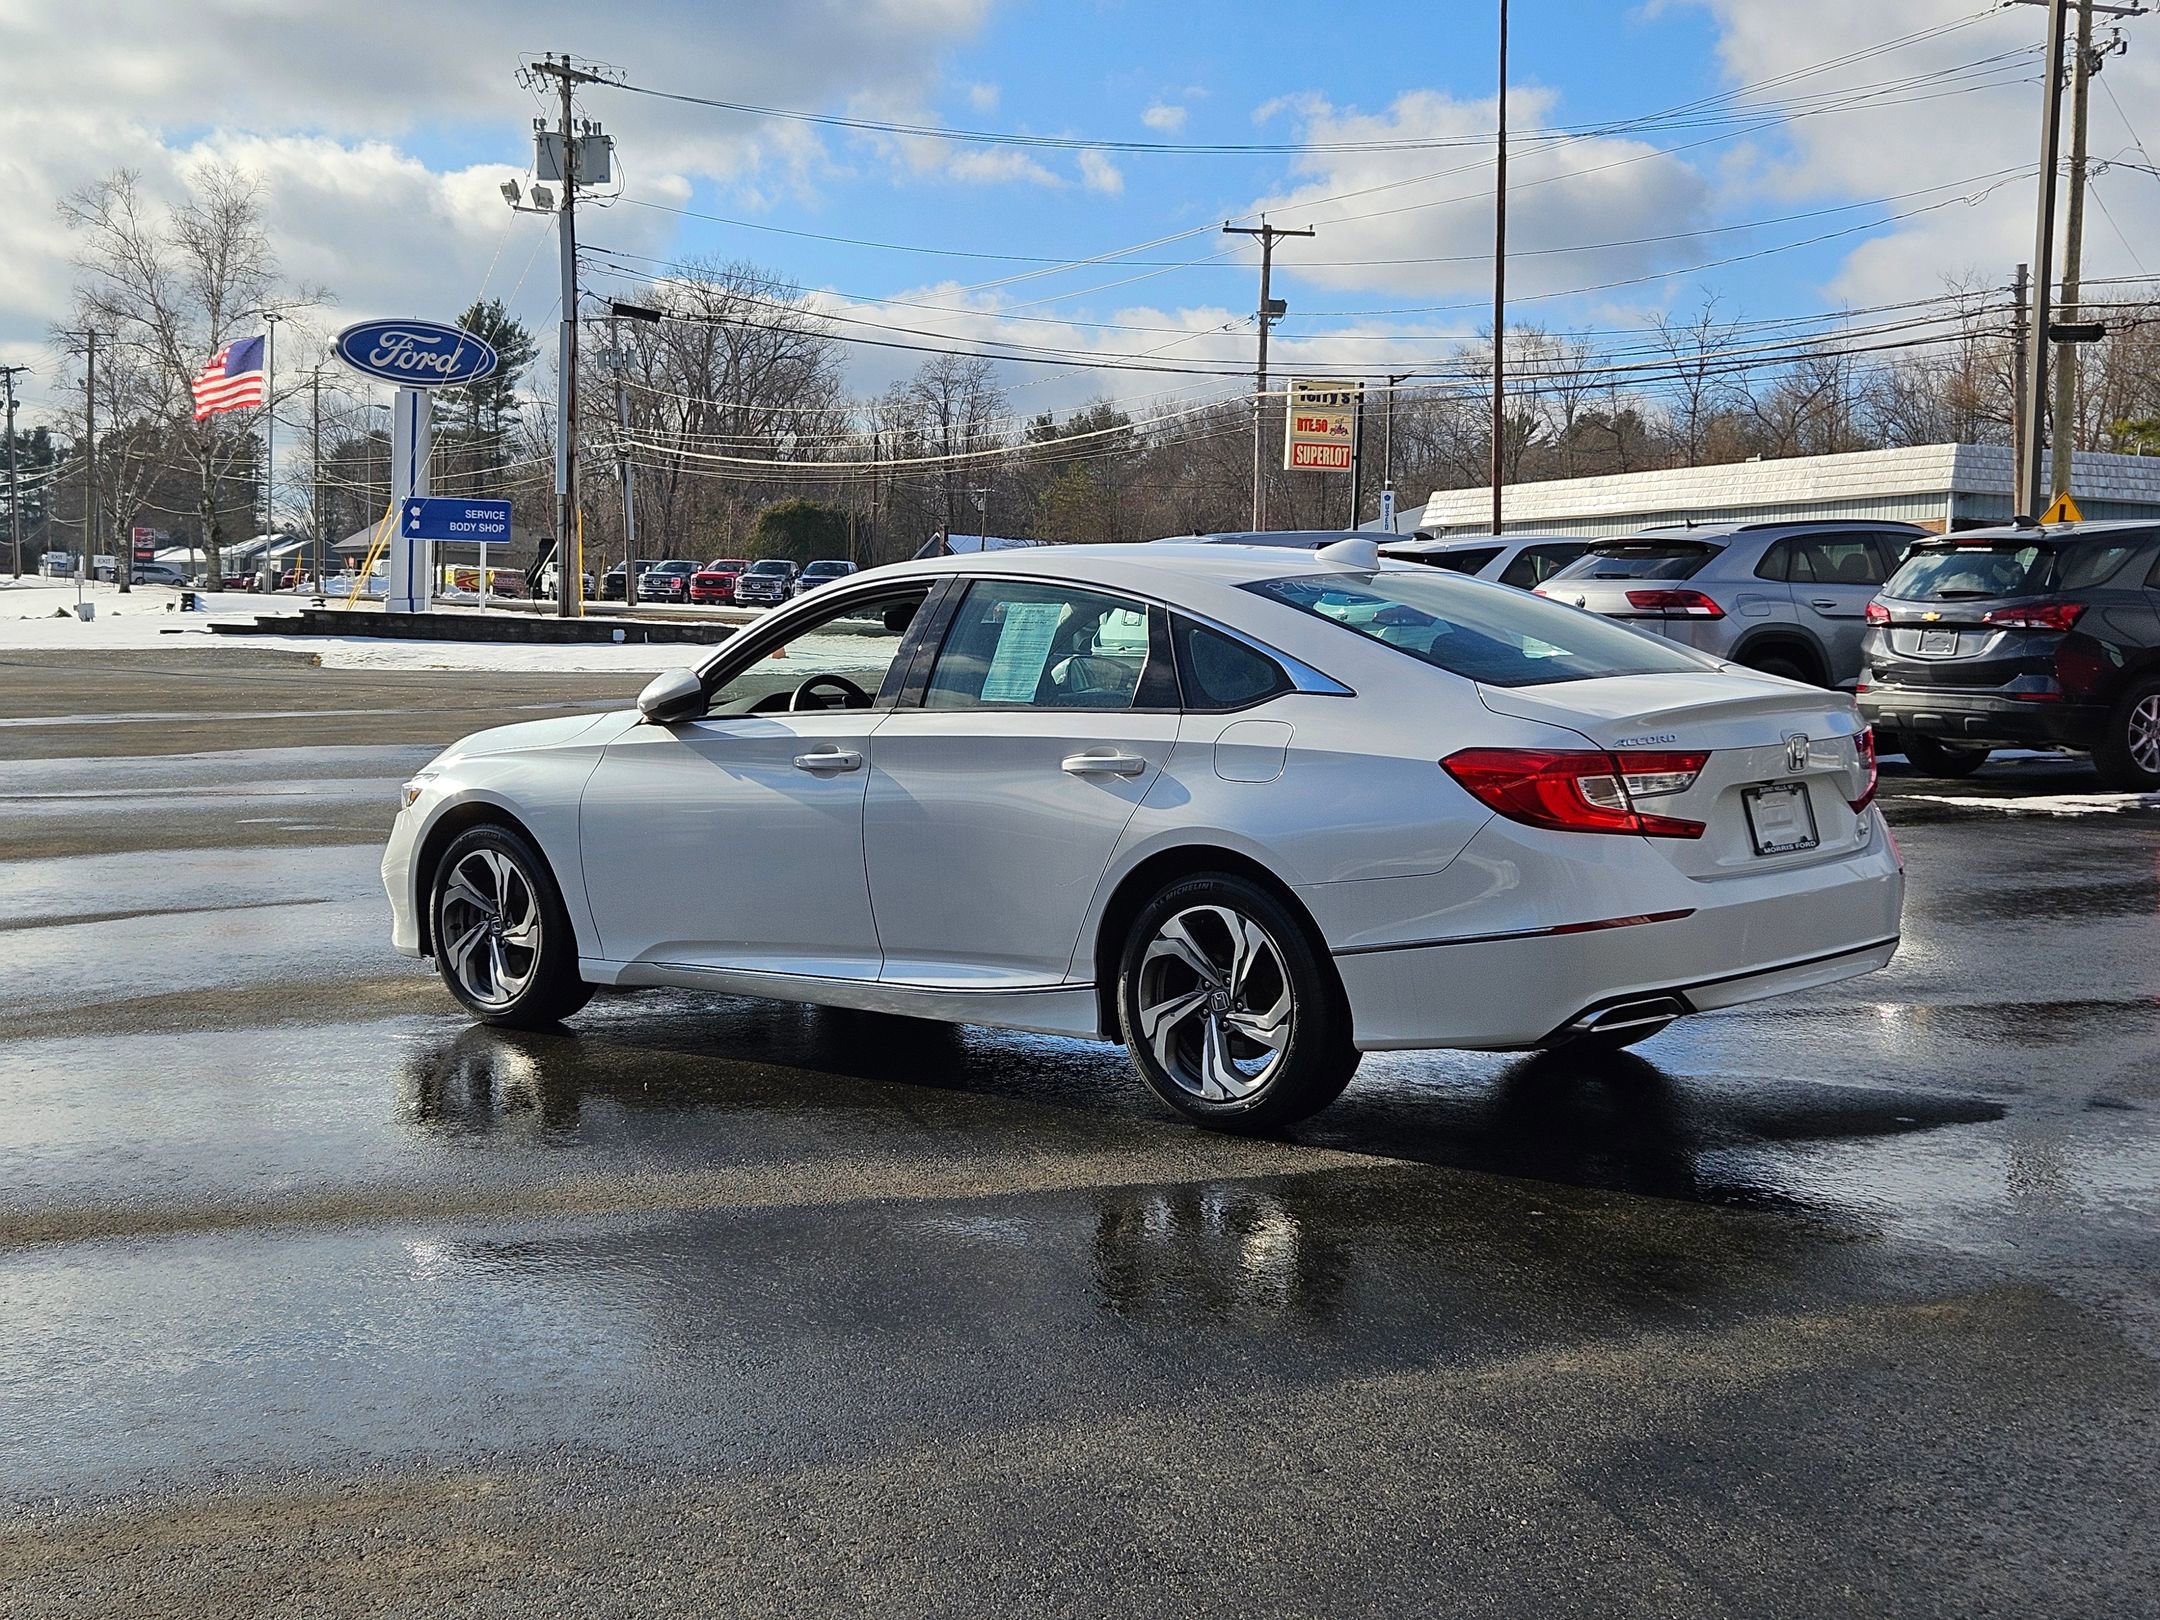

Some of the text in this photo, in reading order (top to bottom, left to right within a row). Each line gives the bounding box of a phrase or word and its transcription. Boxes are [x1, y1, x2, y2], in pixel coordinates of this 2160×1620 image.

[369, 330, 465, 374] Ford
[1296, 444, 1349, 467] SUPERLOT
[464, 509, 506, 521] SERVICE
[449, 521, 505, 533] BODY SHOP
[1613, 734, 1677, 748] ACCORD
[1763, 840, 1817, 854] MORRIS FORD
